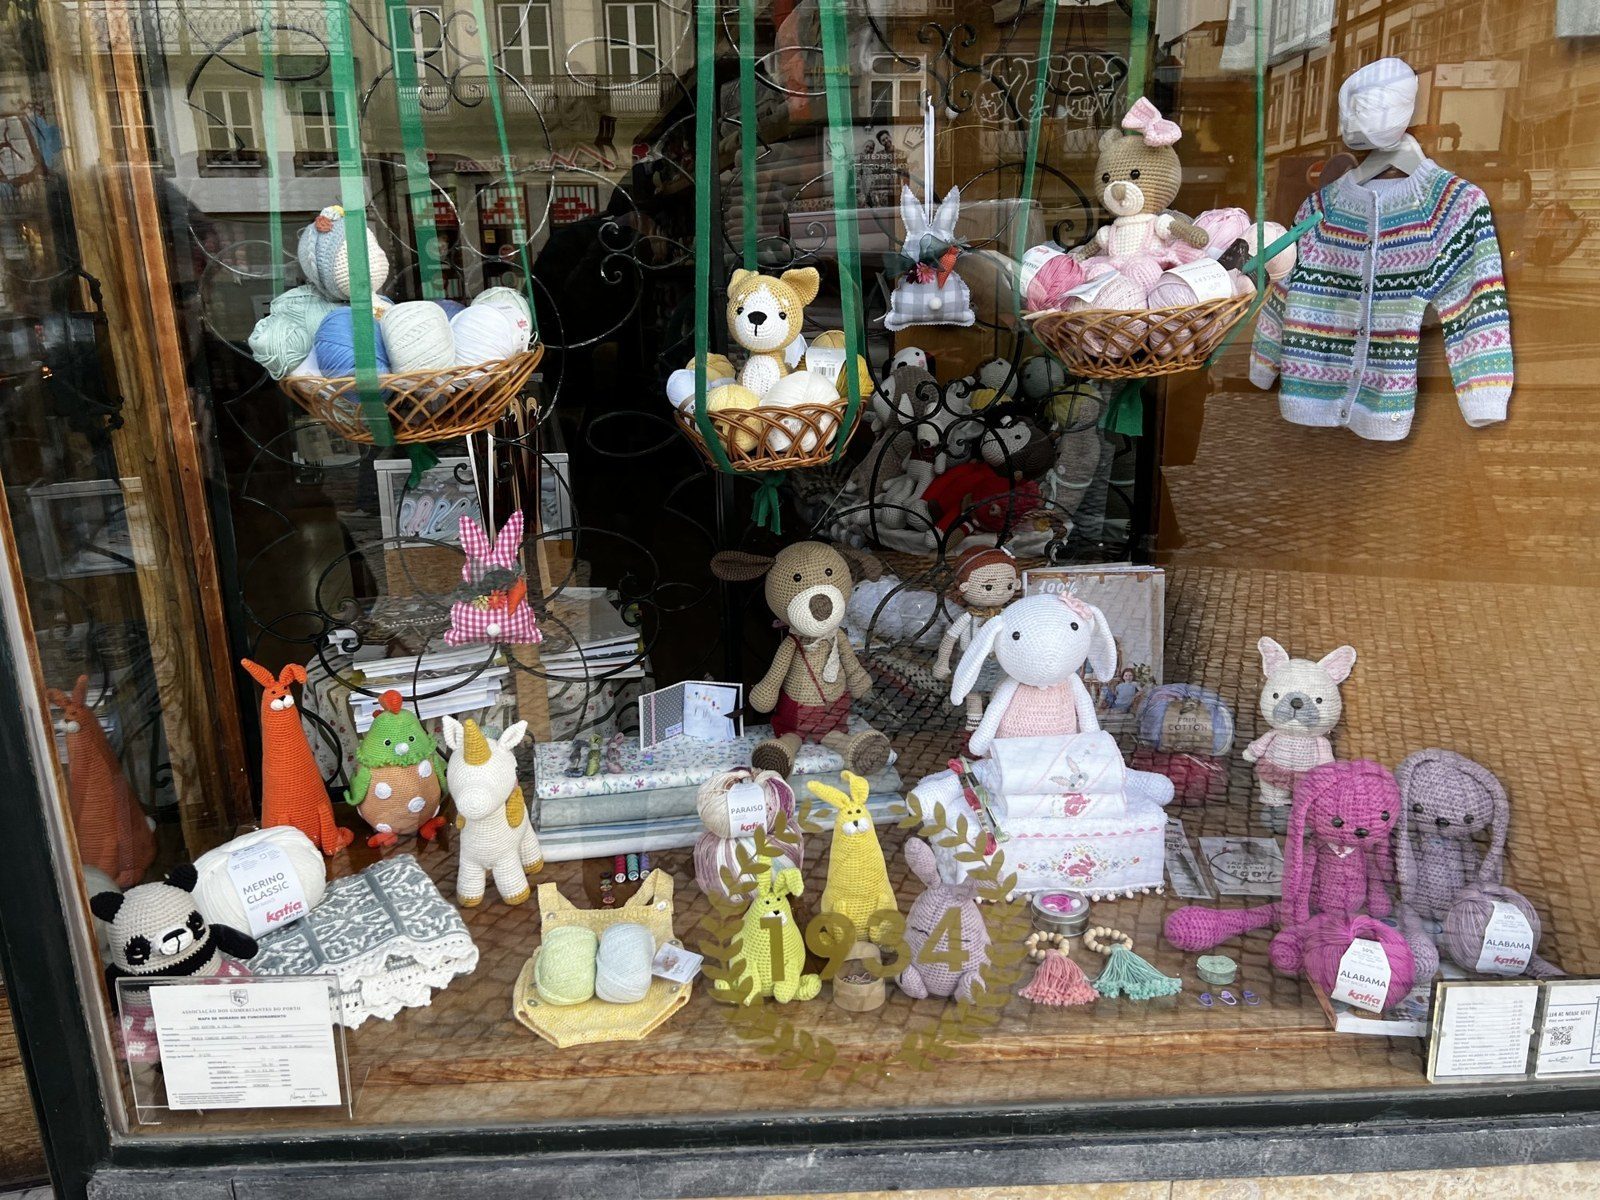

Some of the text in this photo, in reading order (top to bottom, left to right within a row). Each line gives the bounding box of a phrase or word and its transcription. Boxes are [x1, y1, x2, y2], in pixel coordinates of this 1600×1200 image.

[1038, 581, 1078, 594] 100%
[730, 804, 764, 815] PARAISO
[242, 872, 285, 895] MERINO
[246, 881, 290, 905] CLASSIC
[266, 900, 303, 923] katia
[759, 906, 970, 983] 1934
[1486, 938, 1531, 951] ALABAMA
[1493, 955, 1526, 966] katia
[1339, 970, 1387, 989] ALABAMA
[1347, 989, 1381, 1005] katia
